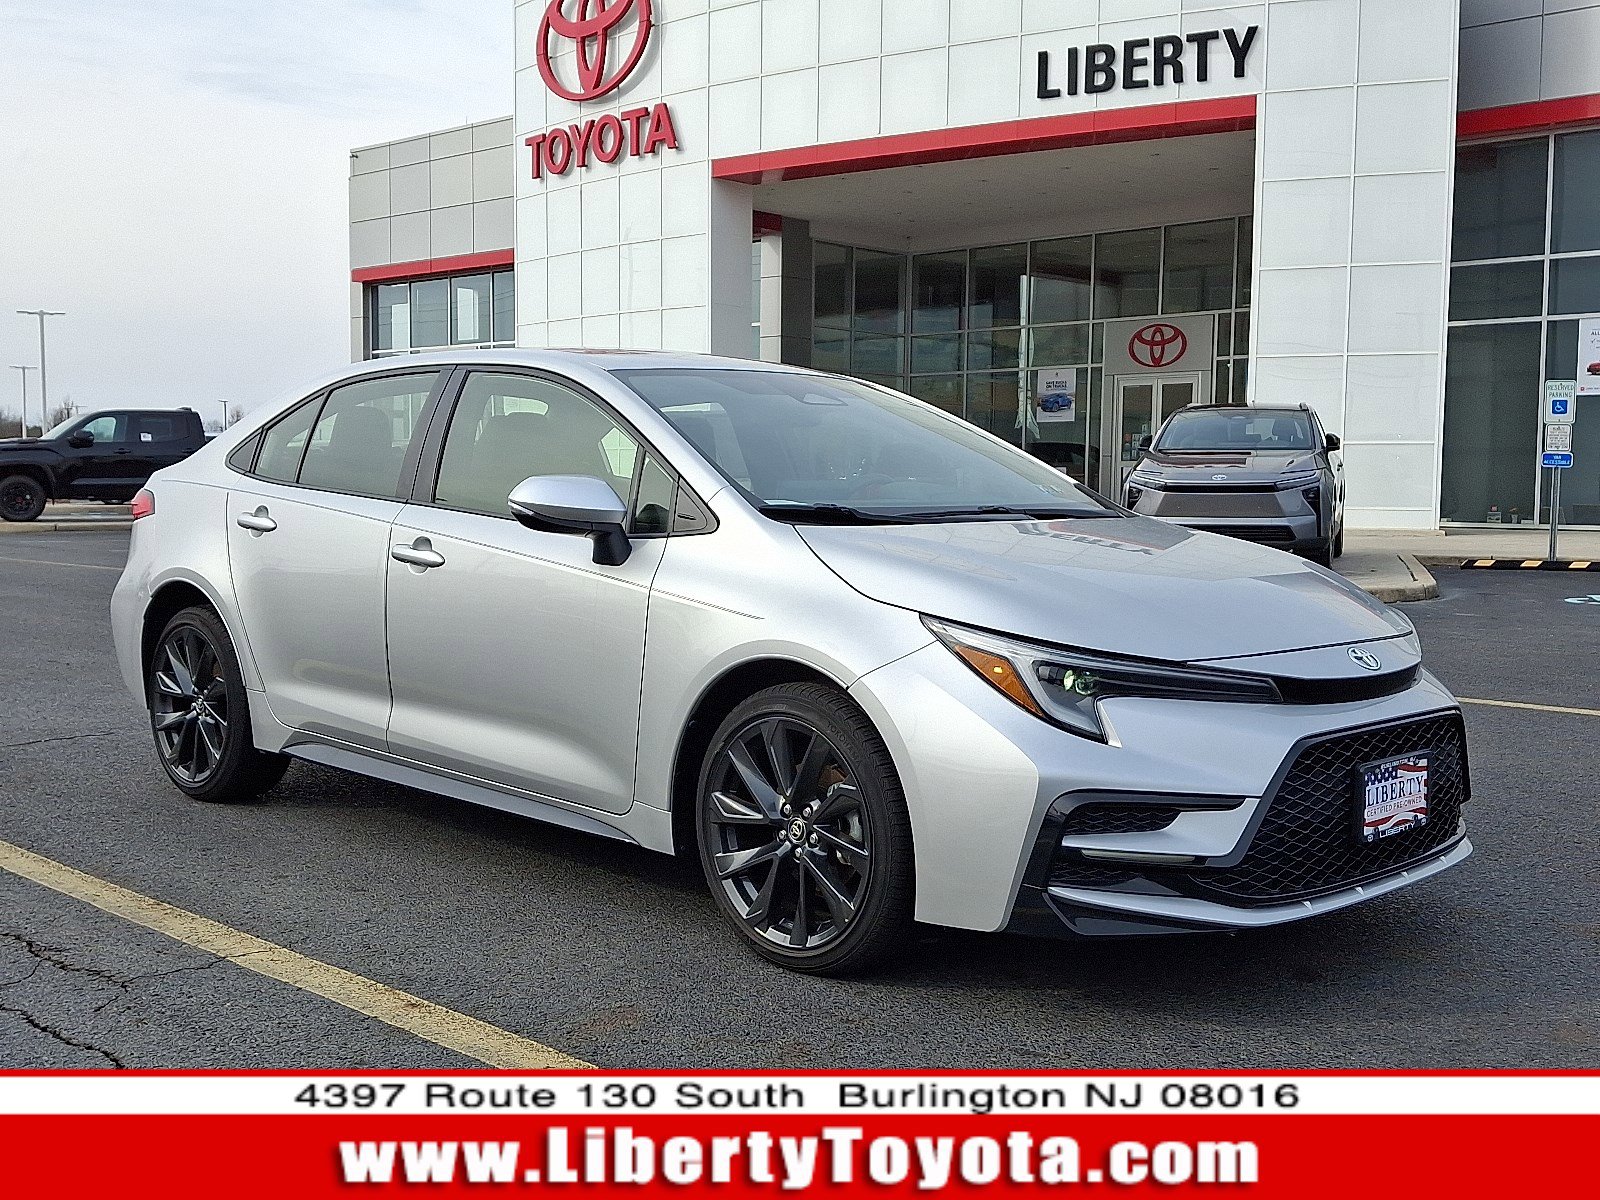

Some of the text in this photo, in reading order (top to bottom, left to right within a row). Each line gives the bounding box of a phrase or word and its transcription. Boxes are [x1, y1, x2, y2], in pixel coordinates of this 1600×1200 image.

[1037, 25, 1258, 99] LIBERTY
[526, 102, 678, 179] TOYOTA
[1366, 795, 1422, 818] CERTIFIED PRE-OWNED
[1367, 775, 1423, 807] LIBERTY
[1379, 821, 1416, 838] LIBERTY
